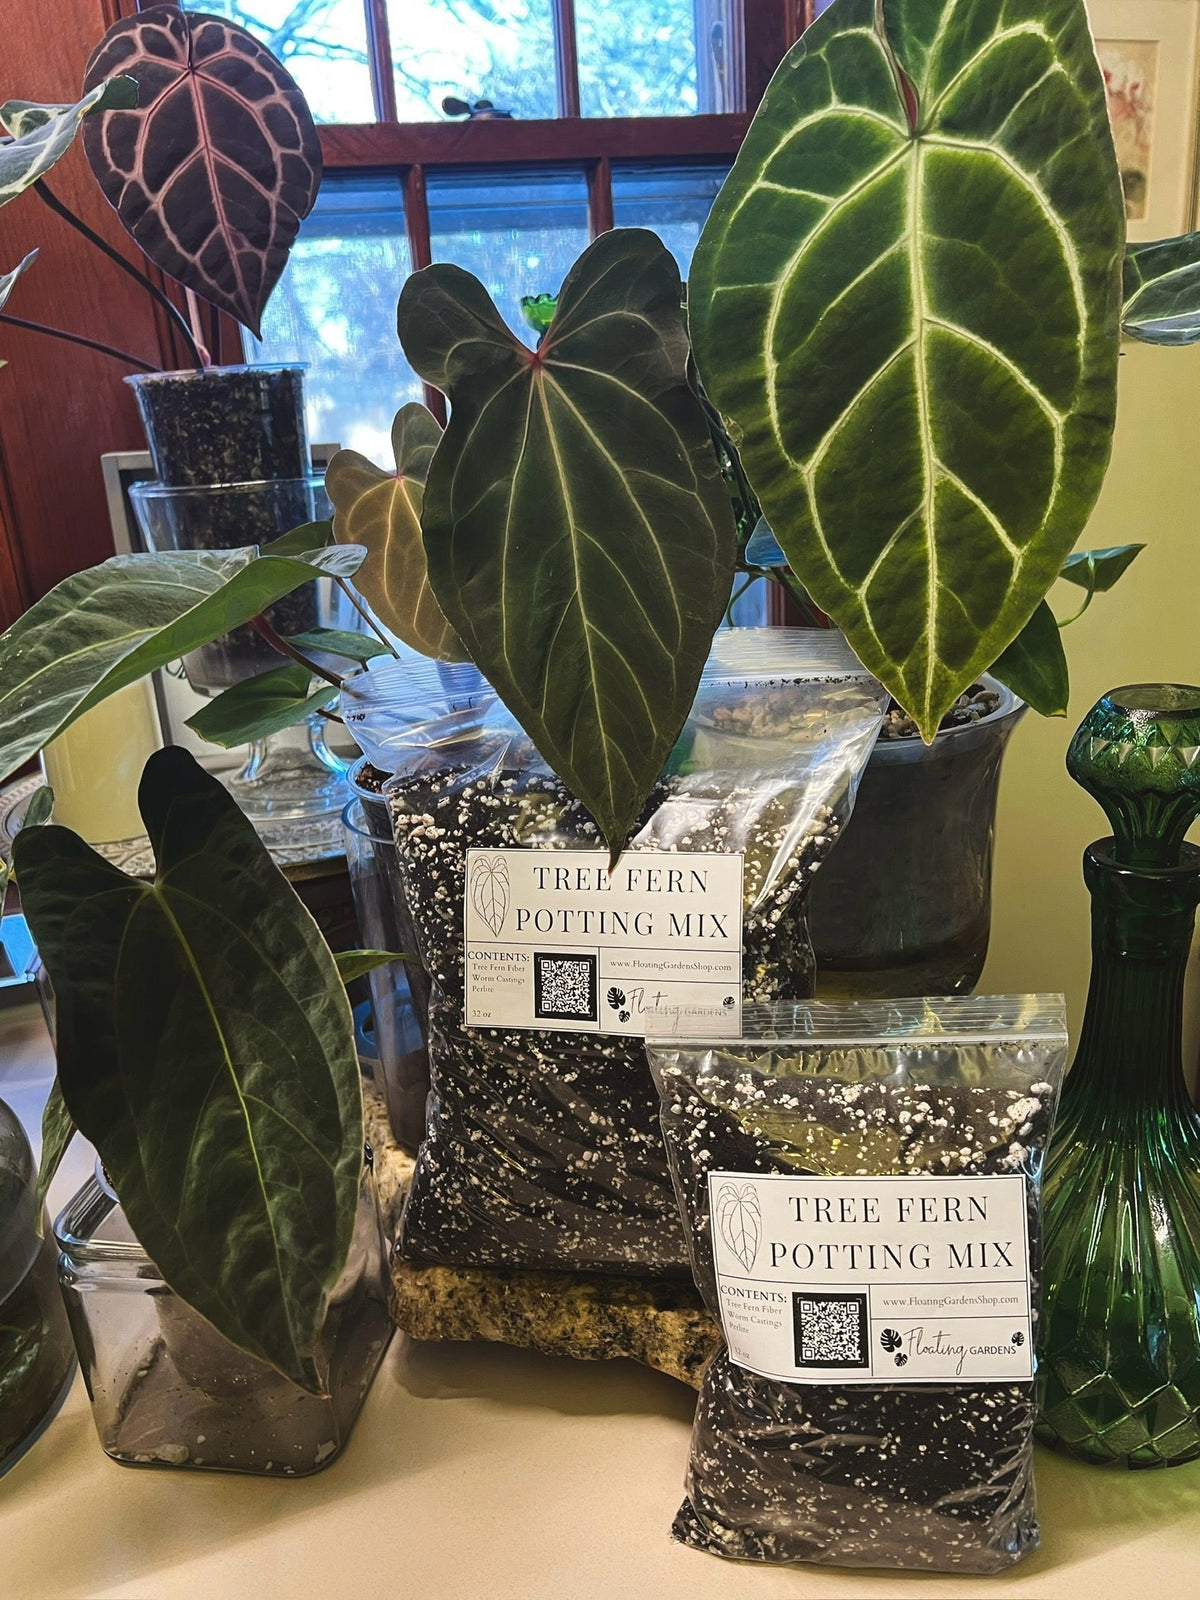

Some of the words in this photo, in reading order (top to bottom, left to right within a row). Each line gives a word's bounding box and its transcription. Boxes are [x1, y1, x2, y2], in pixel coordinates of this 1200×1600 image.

[533, 867, 612, 891] TREE
[625, 869, 708, 893] FERN
[515, 908, 653, 936] POTTING
[668, 912, 729, 939] MIX
[468, 951, 530, 962] CONTENTS:
[472, 963, 488, 971] Tree
[490, 963, 506, 971] Fern
[507, 964, 525, 972] Fiber
[610, 960, 732, 973] www.FloatingGardensShop.com
[472, 974, 495, 982] Worm
[496, 975, 525, 984] Castings
[472, 985, 494, 993] Perlite
[472, 1009, 481, 1018] 32
[789, 1196, 880, 1223] TREE
[896, 1195, 989, 1223] FERN
[769, 1242, 931, 1270] POTTING
[948, 1241, 1014, 1270] MIX
[720, 1285, 787, 1303] CONTENTS:
[883, 1295, 1019, 1308] www.FloatingGardensShop.com
[726, 1298, 742, 1308] Tree
[743, 1302, 760, 1312] Fern
[762, 1305, 782, 1314] Fiber
[727, 1310, 749, 1321] Worm
[750, 1315, 783, 1329] Castings
[903, 1327, 968, 1375] Floating
[969, 1346, 1017, 1355] GARDENS
